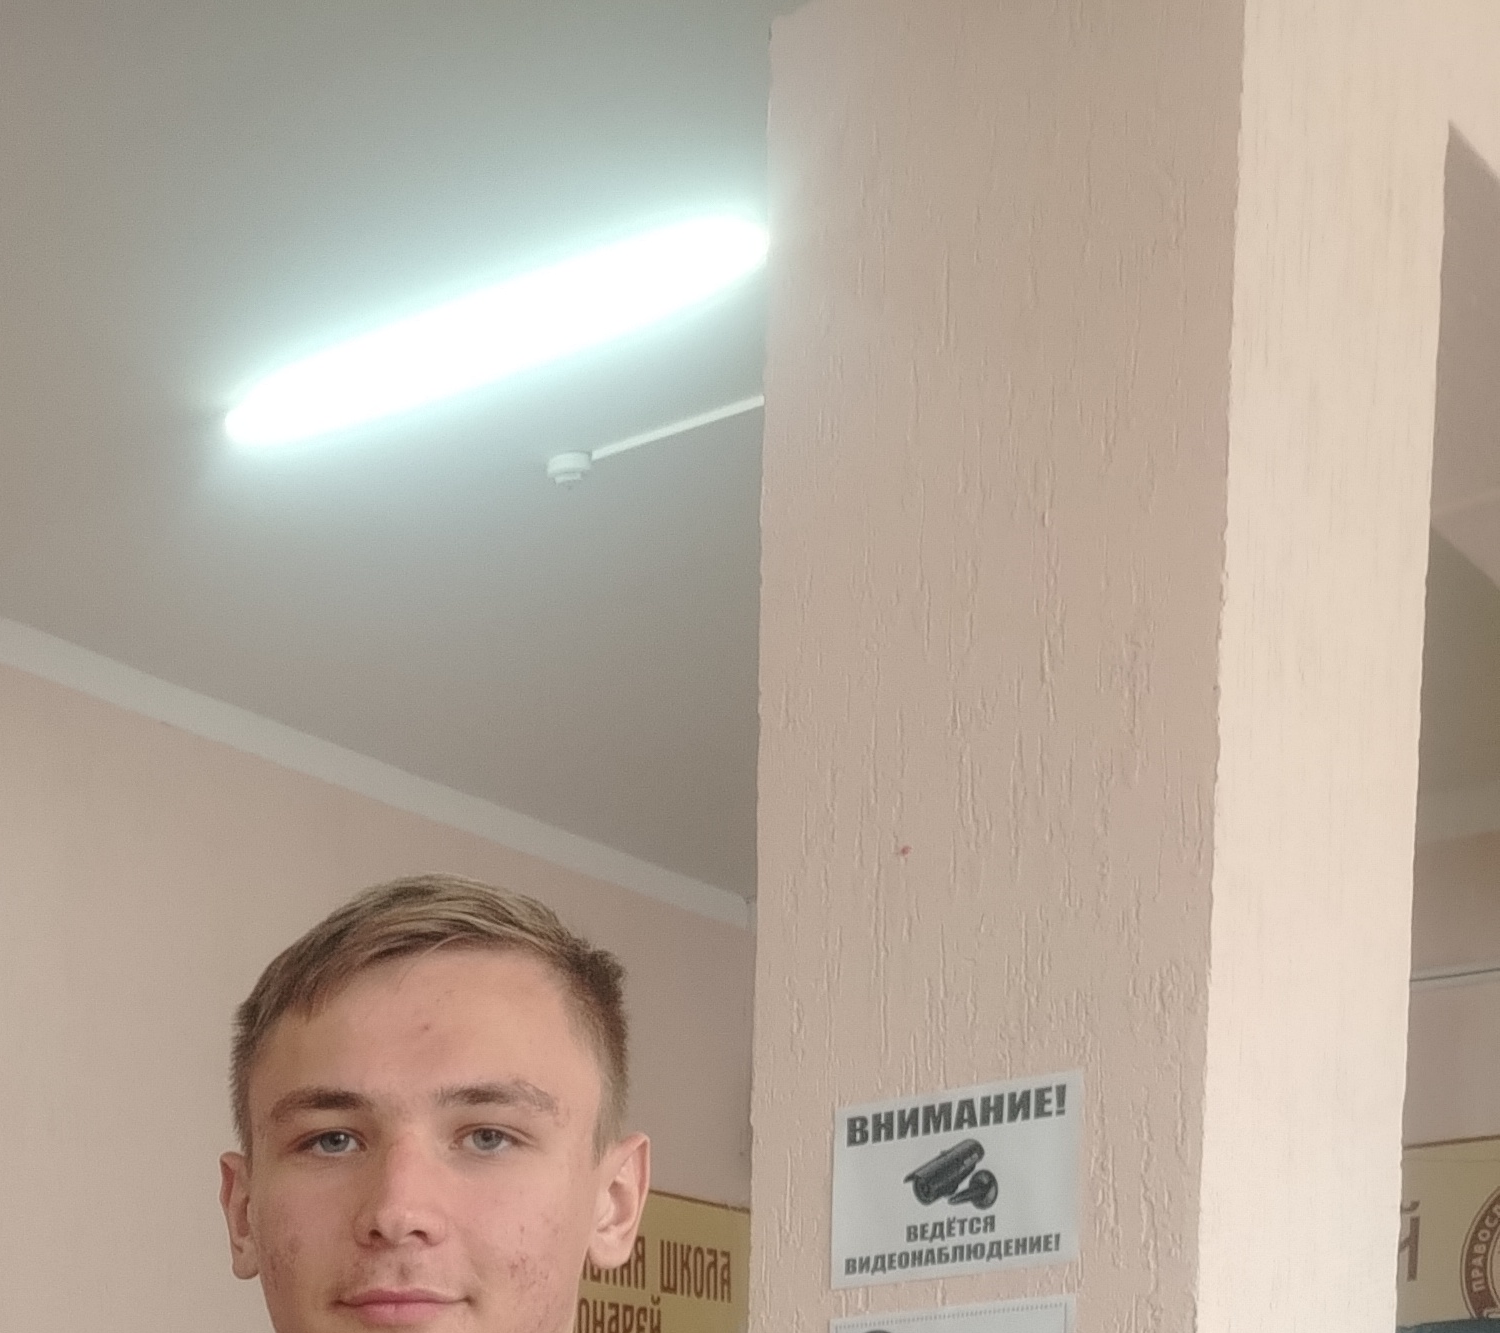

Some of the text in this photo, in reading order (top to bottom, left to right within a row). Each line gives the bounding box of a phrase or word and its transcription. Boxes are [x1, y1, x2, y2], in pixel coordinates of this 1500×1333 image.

[846, 1083, 1067, 1148] ВНИМАНИЕ!
[844, 1233, 1062, 1276] ВИДЕОНАБЛЮДЕНИЕ!
[905, 1214, 996, 1243] ВЕДЁТСЯ
[659, 1239, 732, 1303] ШКОЛА
